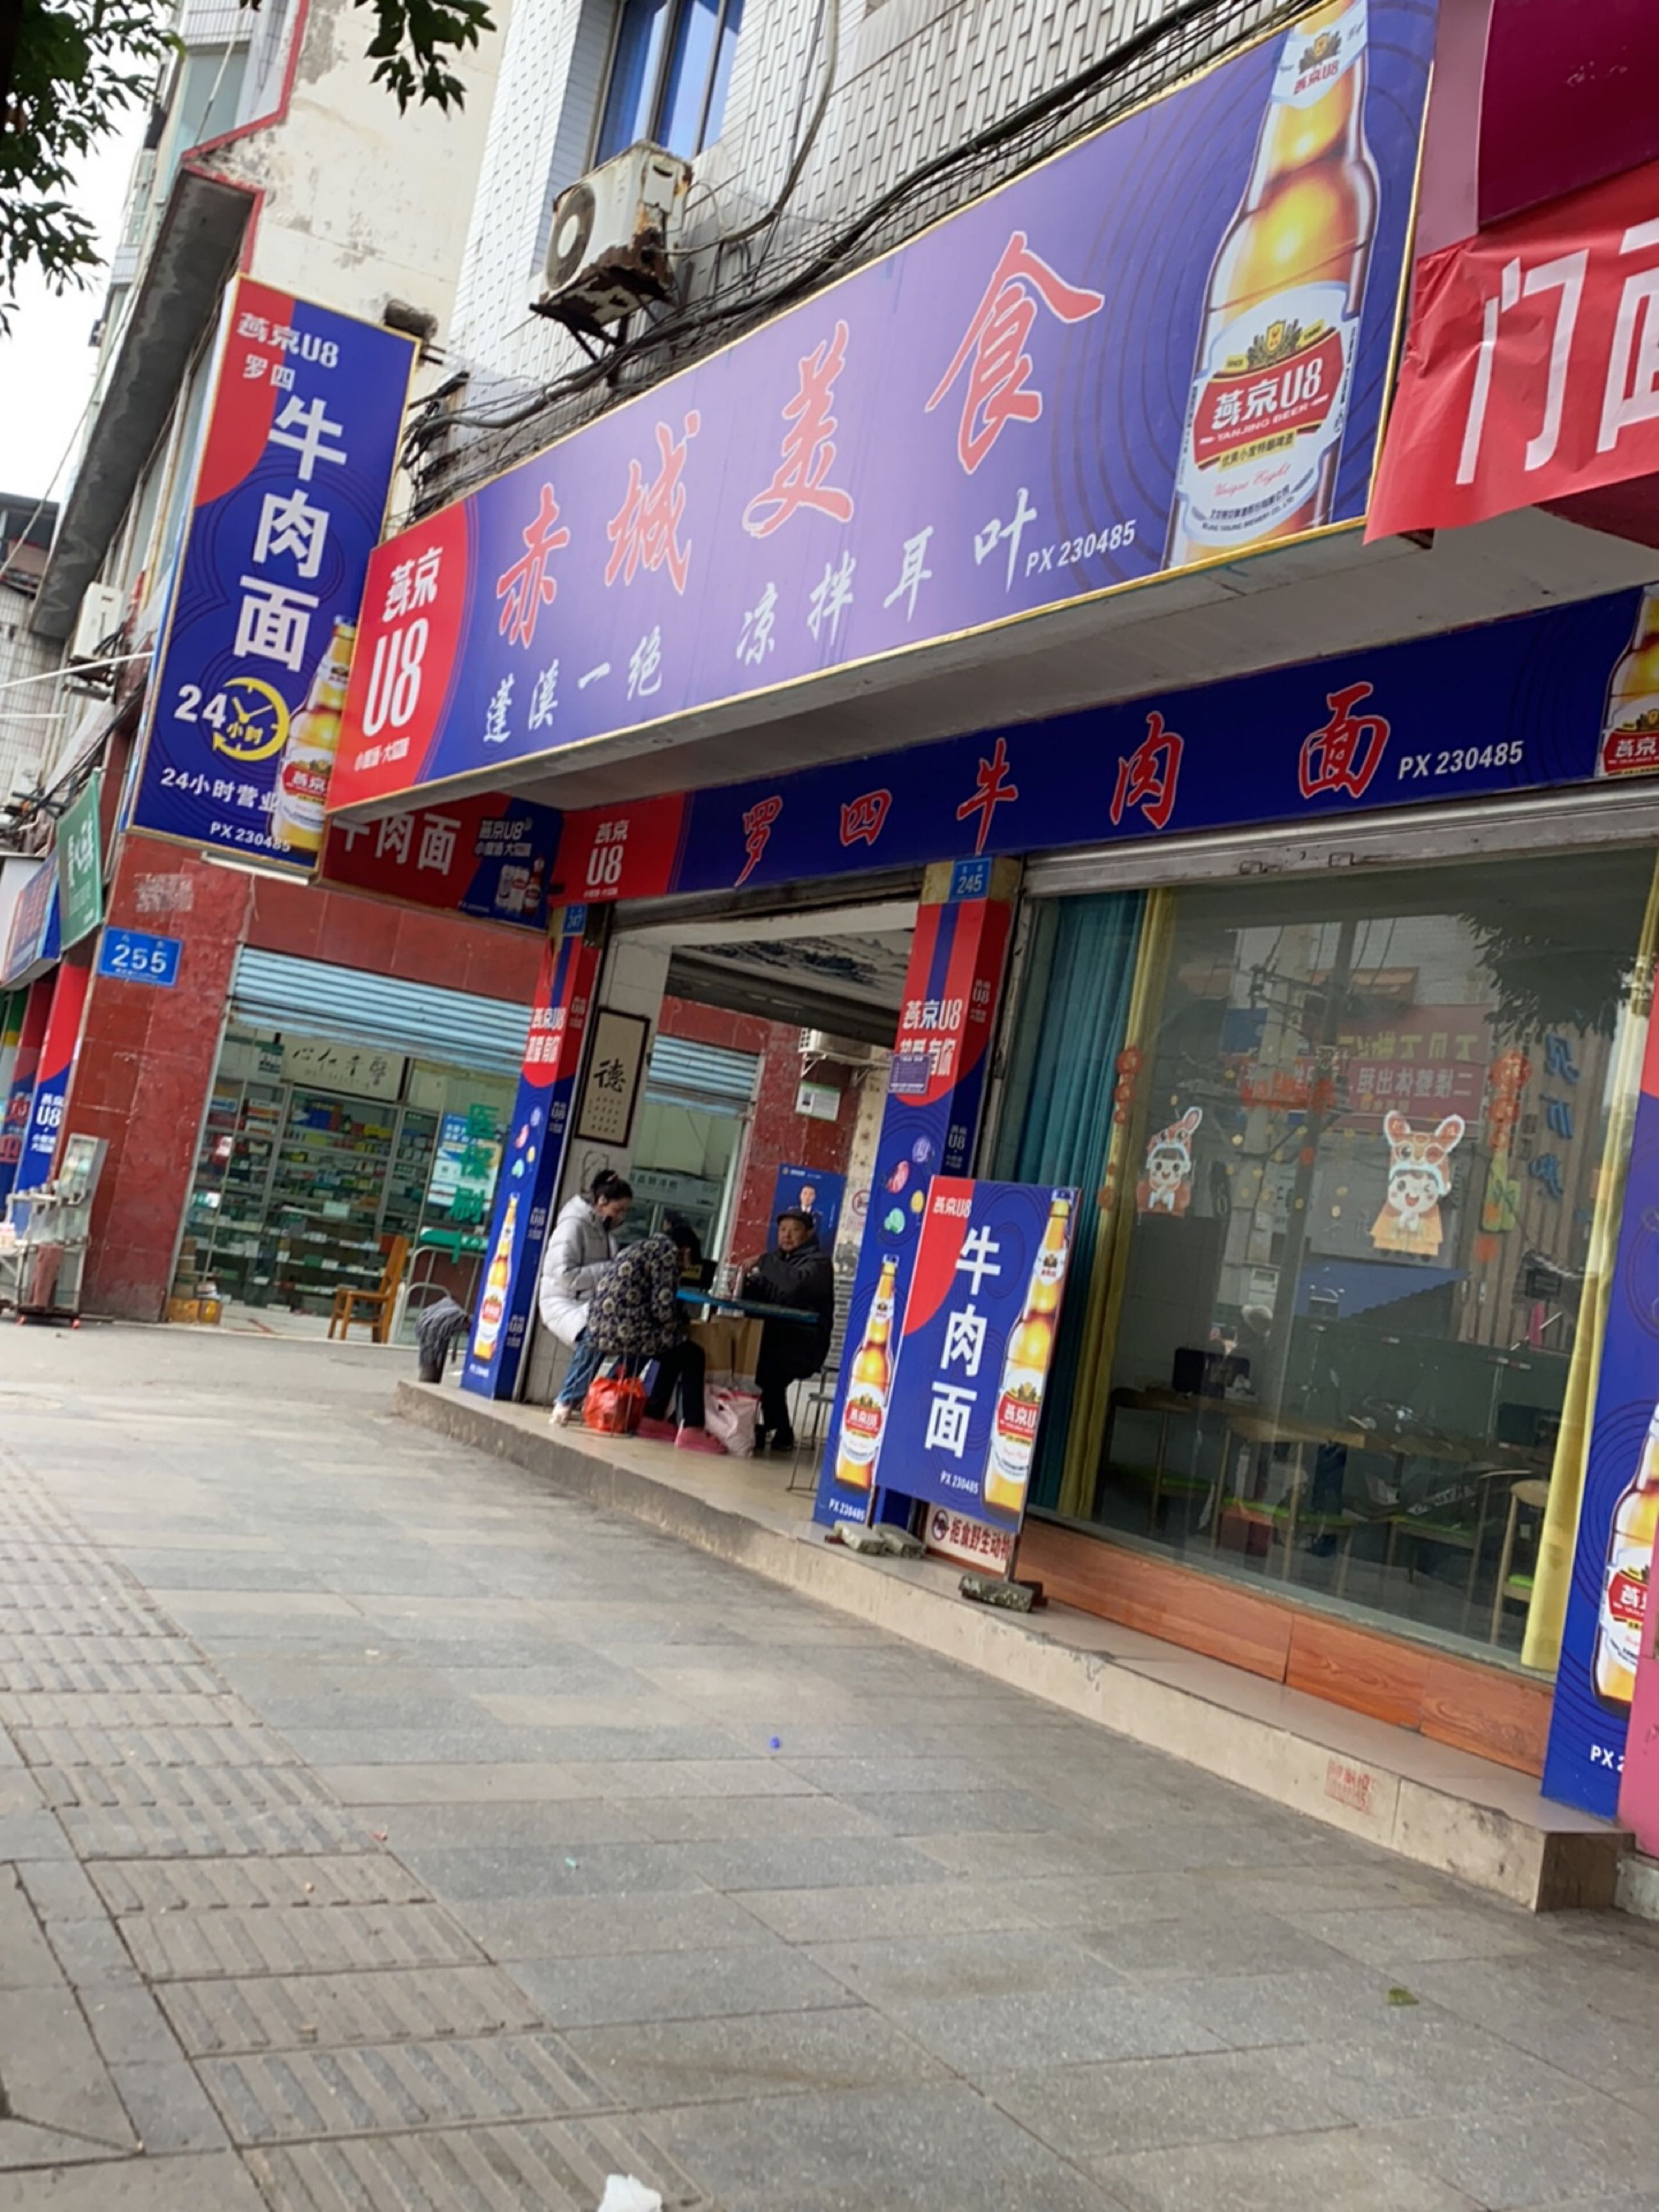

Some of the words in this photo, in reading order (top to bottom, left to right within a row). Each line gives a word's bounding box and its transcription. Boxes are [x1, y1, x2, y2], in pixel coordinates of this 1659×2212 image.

[237, 312, 340, 369] 燕京U8
[243, 355, 296, 392] 罗四
[1212, 358, 1323, 430] 燕京U8
[496, 231, 1105, 650] 赤城美食
[234, 397, 347, 673] 牛肉面
[1025, 547, 1053, 578] PX
[1057, 519, 1137, 568] 230485
[382, 546, 443, 623] 燕京
[736, 487, 1037, 666] 凉拌耳叶
[362, 618, 429, 737] U8
[173, 685, 228, 728] 24
[226, 721, 264, 745] 小时
[1399, 755, 1432, 780] PX
[1435, 739, 1525, 776] 230485
[161, 767, 279, 813] 24小时营业
[735, 680, 1391, 888] 罗四牛肉面
[210, 821, 232, 840] PX
[235, 827, 292, 854] 230485
[588, 846, 623, 886] U8
[957, 873, 984, 895] 245
[111, 943, 168, 974] 255
[902, 998, 963, 1031] 燕京U8
[593, 1057, 627, 1094] 德
[36, 1105, 61, 1128] U8
[933, 1196, 972, 1218] 燕京U8
[924, 1226, 1001, 1457] 牛肉面
[940, 1471, 951, 1485] PX
[952, 1475, 979, 1495] 230485
[1590, 1743, 1615, 1772] PX
